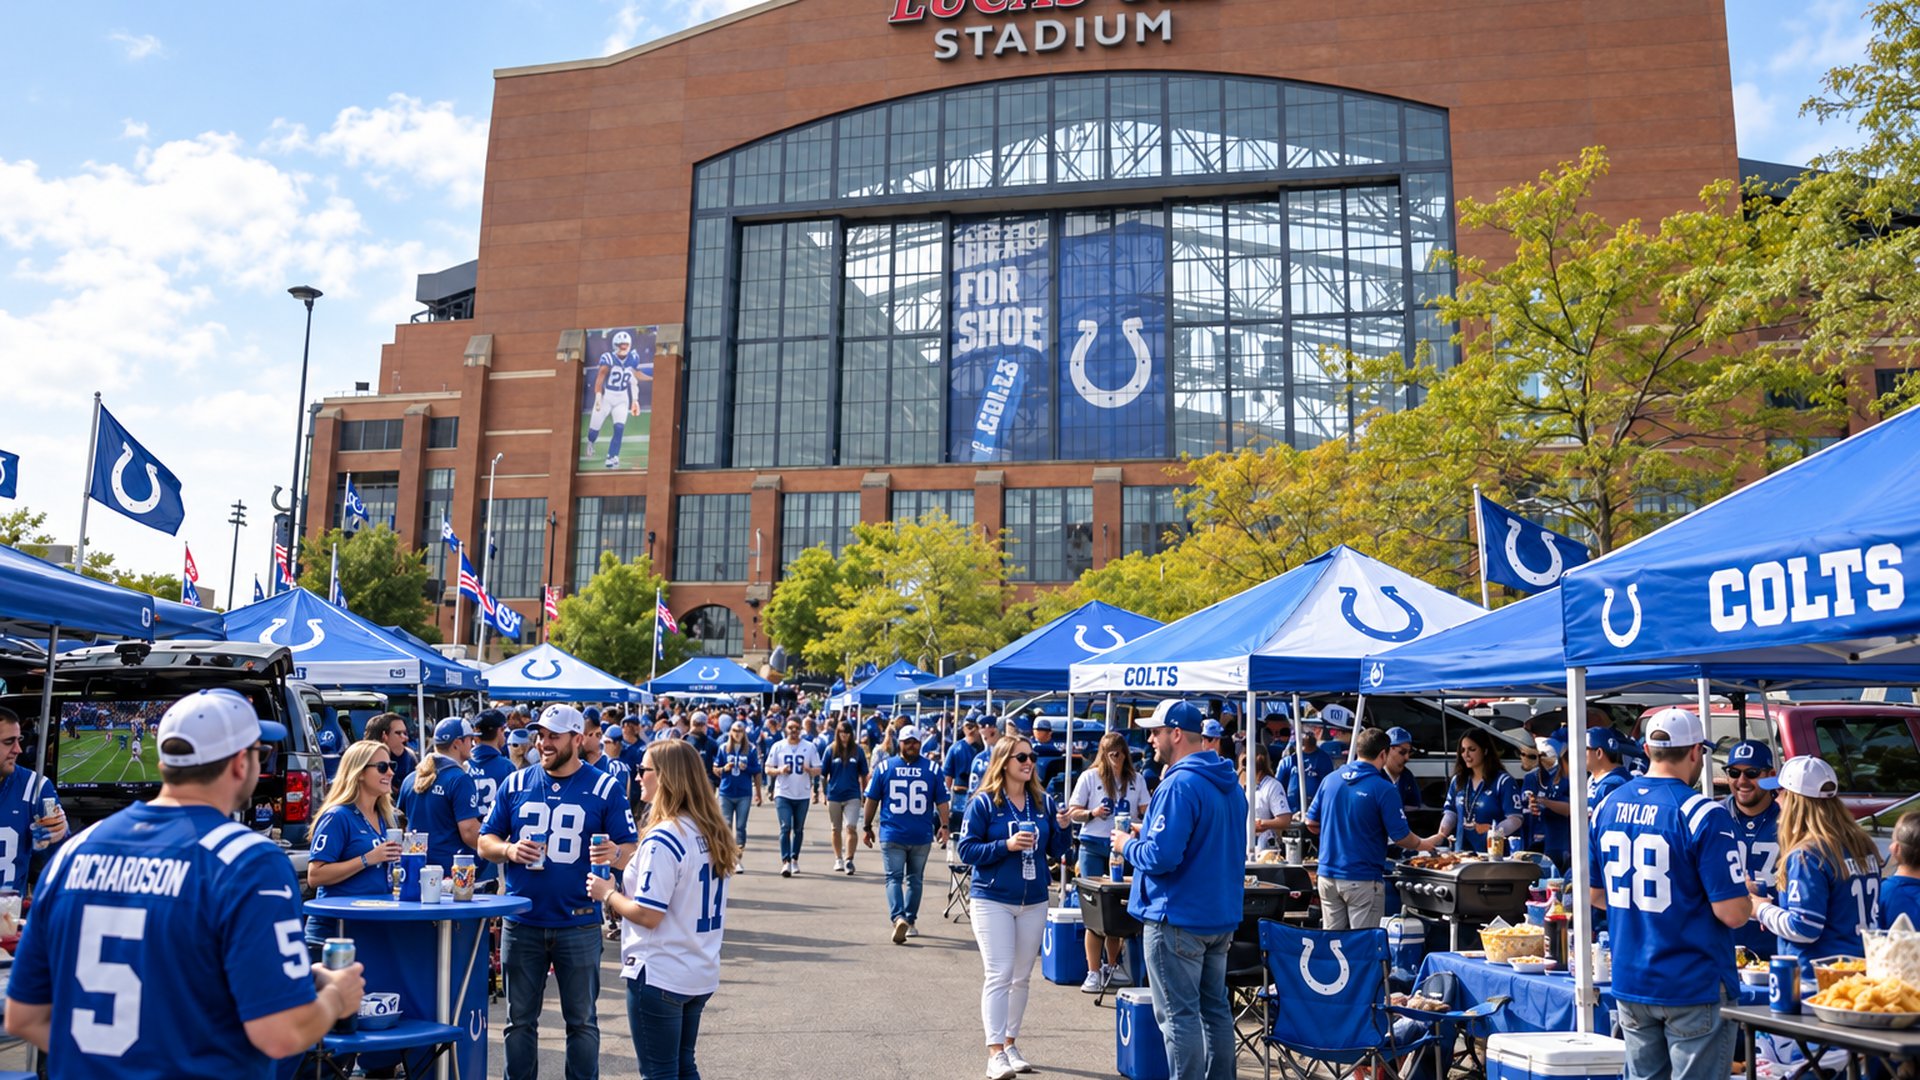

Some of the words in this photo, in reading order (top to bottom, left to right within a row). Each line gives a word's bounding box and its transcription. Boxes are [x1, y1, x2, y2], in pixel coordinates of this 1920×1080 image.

[934, 10, 1172, 59] STADIUM
[960, 265, 1020, 308] FOR
[958, 306, 1043, 352] SHOE
[1708, 543, 1905, 633] COLTS
[1124, 666, 1178, 687] COLTS
[889, 780, 928, 815] 56
[1615, 802, 1658, 826] TAYLOR
[519, 801, 586, 864] 28
[64, 855, 191, 898] RICHARDSON
[1600, 830, 1672, 913] 28
[274, 918, 310, 980] 5
[71, 904, 147, 1057] 5
